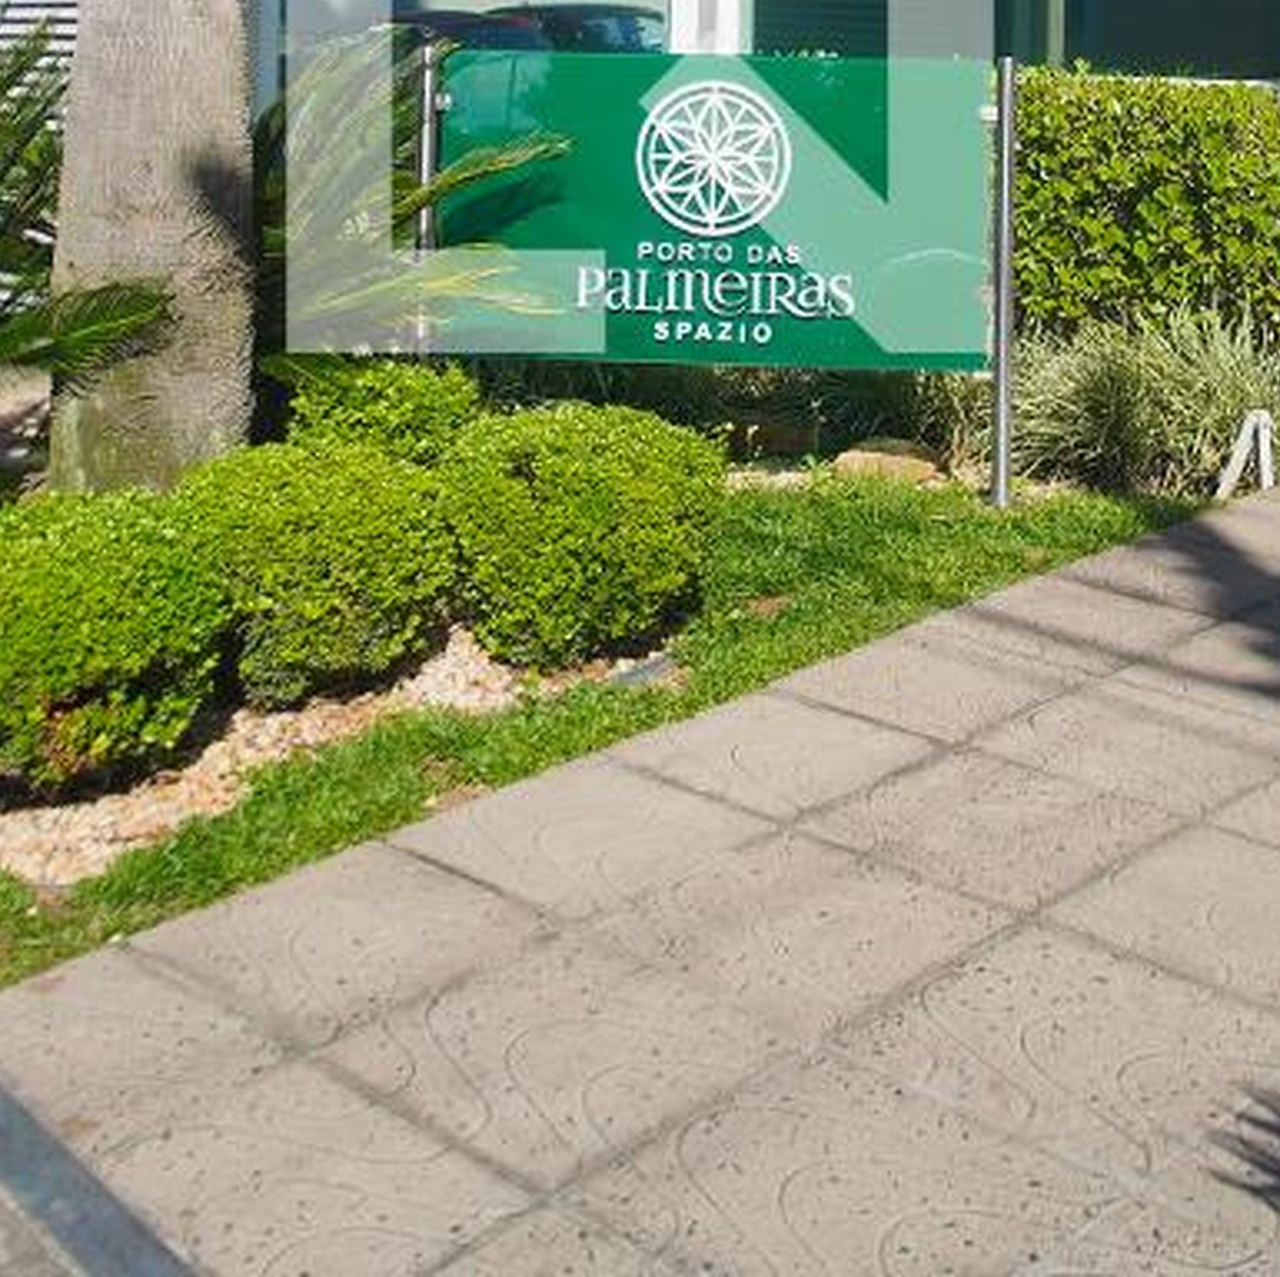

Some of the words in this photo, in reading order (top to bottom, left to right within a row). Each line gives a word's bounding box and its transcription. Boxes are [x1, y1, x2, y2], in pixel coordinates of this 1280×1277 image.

[636, 241, 733, 263] PORTO
[747, 244, 801, 266] DAS
[653, 321, 773, 344] SPAZIO
